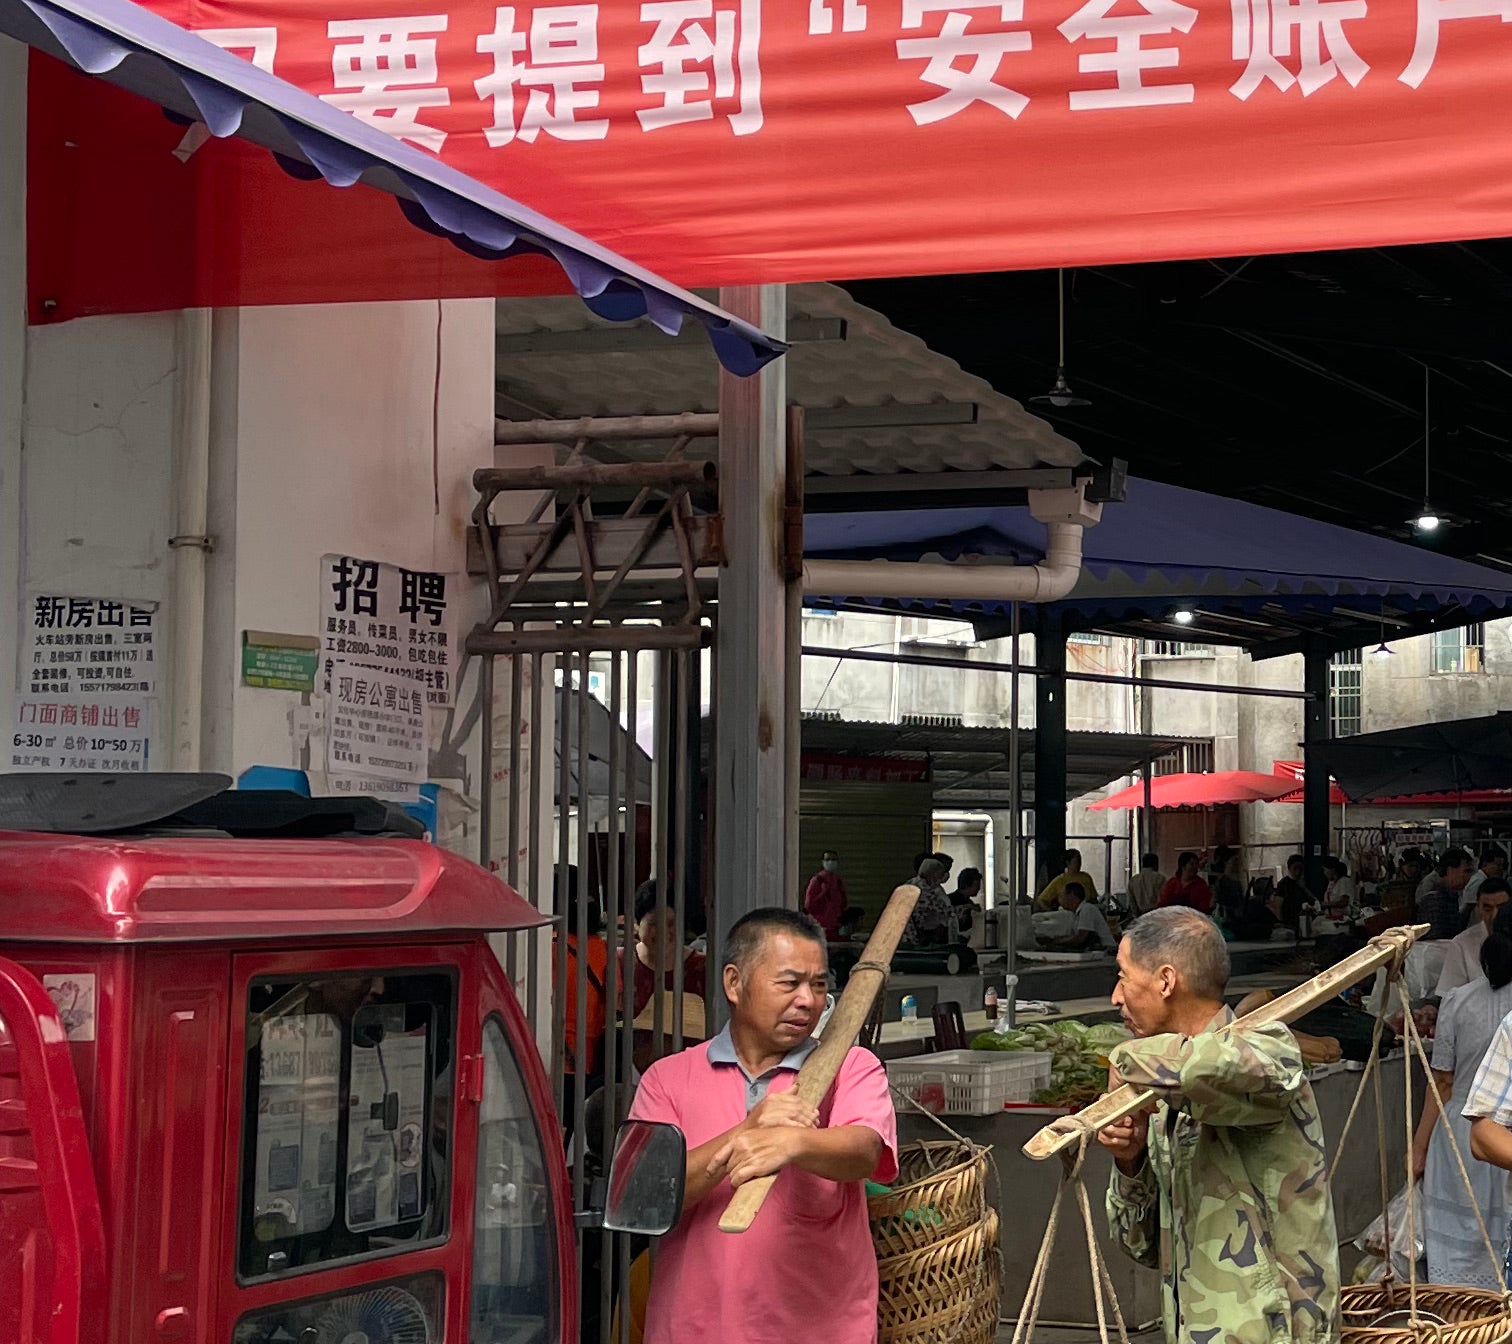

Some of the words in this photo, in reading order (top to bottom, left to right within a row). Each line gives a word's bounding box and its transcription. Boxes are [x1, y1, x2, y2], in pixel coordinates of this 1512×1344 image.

[331, 557, 447, 626] 招聘
[20, 703, 140, 728] 门面商铺出售
[338, 676, 423, 716] 现房公寓出售
